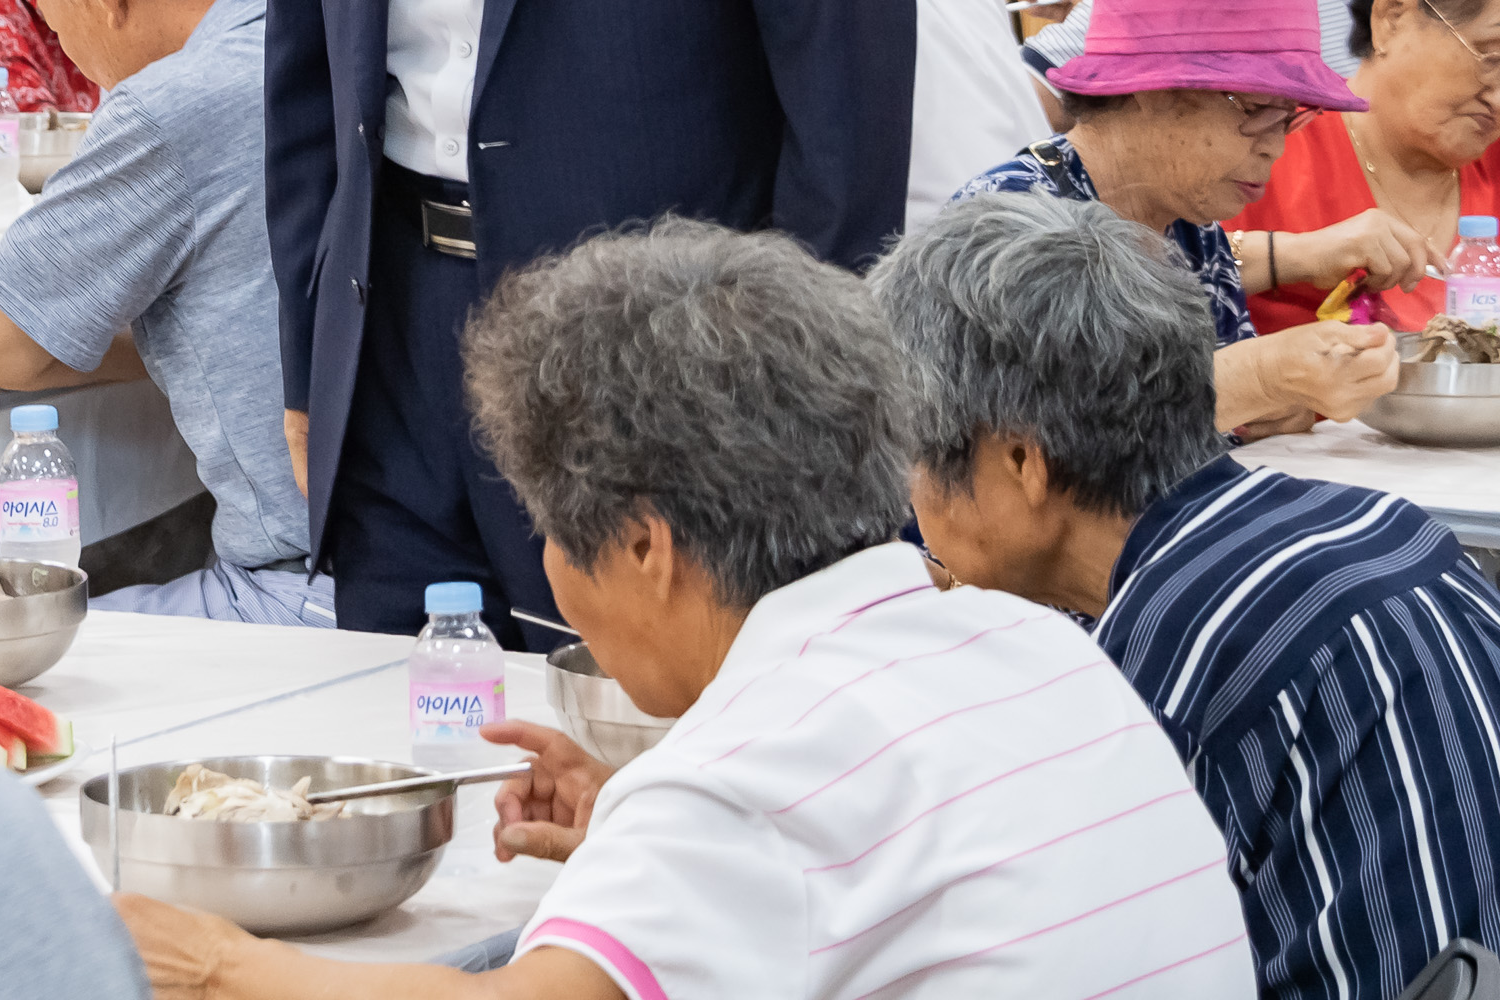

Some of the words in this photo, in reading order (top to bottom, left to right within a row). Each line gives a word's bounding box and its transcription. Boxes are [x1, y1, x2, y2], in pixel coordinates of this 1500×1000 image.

[2, 500, 59, 517] 아이시스
[42, 516, 59, 528] 8.0
[417, 695, 484, 715] 아이시스
[465, 714, 484, 727] 8.0
